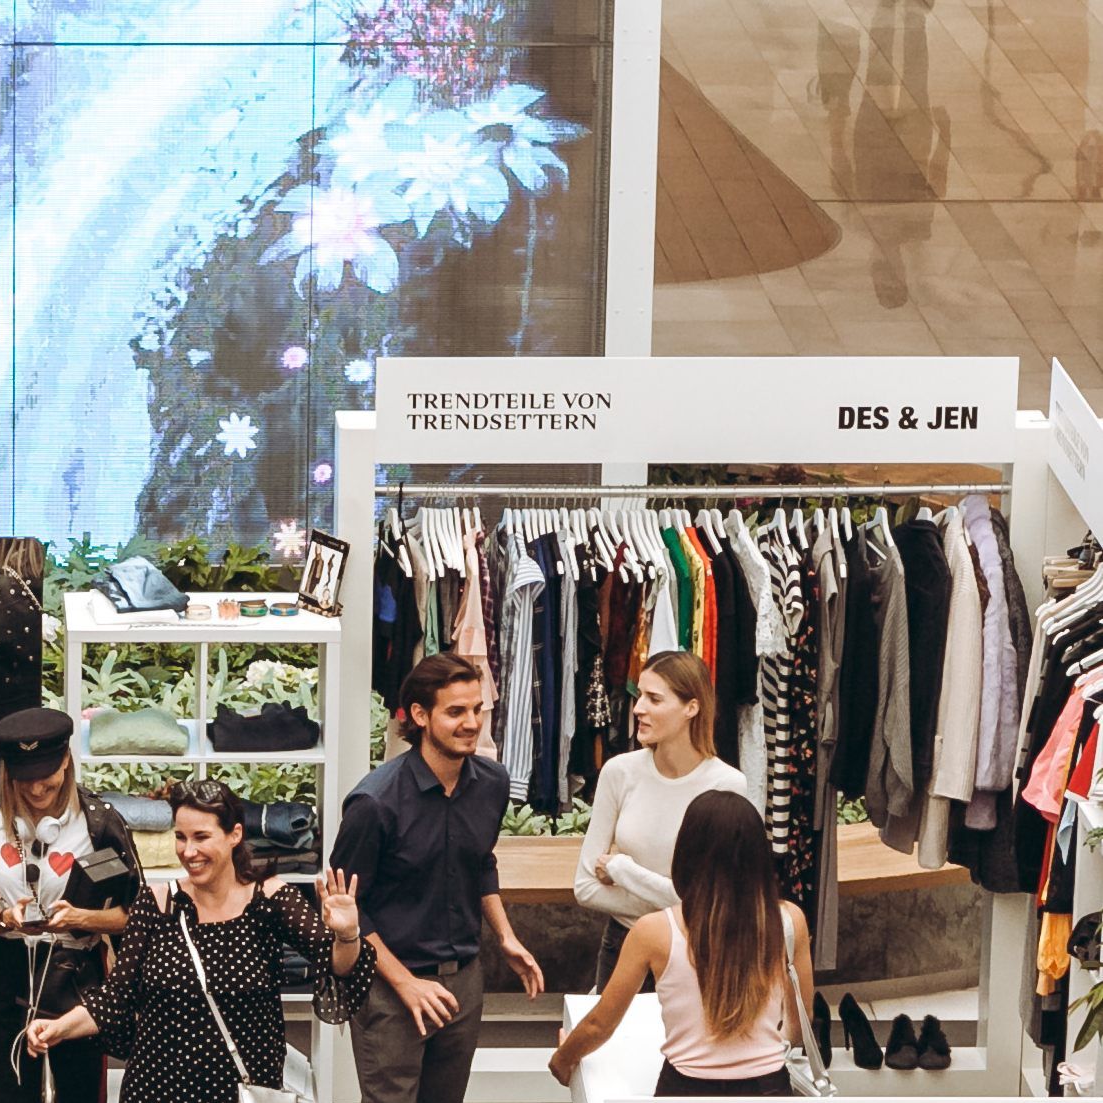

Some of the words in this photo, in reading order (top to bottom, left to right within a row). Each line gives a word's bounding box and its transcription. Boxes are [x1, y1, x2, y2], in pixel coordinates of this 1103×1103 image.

[406, 393, 556, 410] TRENDTEILE
[563, 393, 612, 410] VON
[406, 413, 597, 430] TRENDSETTERN
[838, 406, 890, 430] DES
[898, 406, 919, 430] &
[926, 406, 979, 430] JEN
